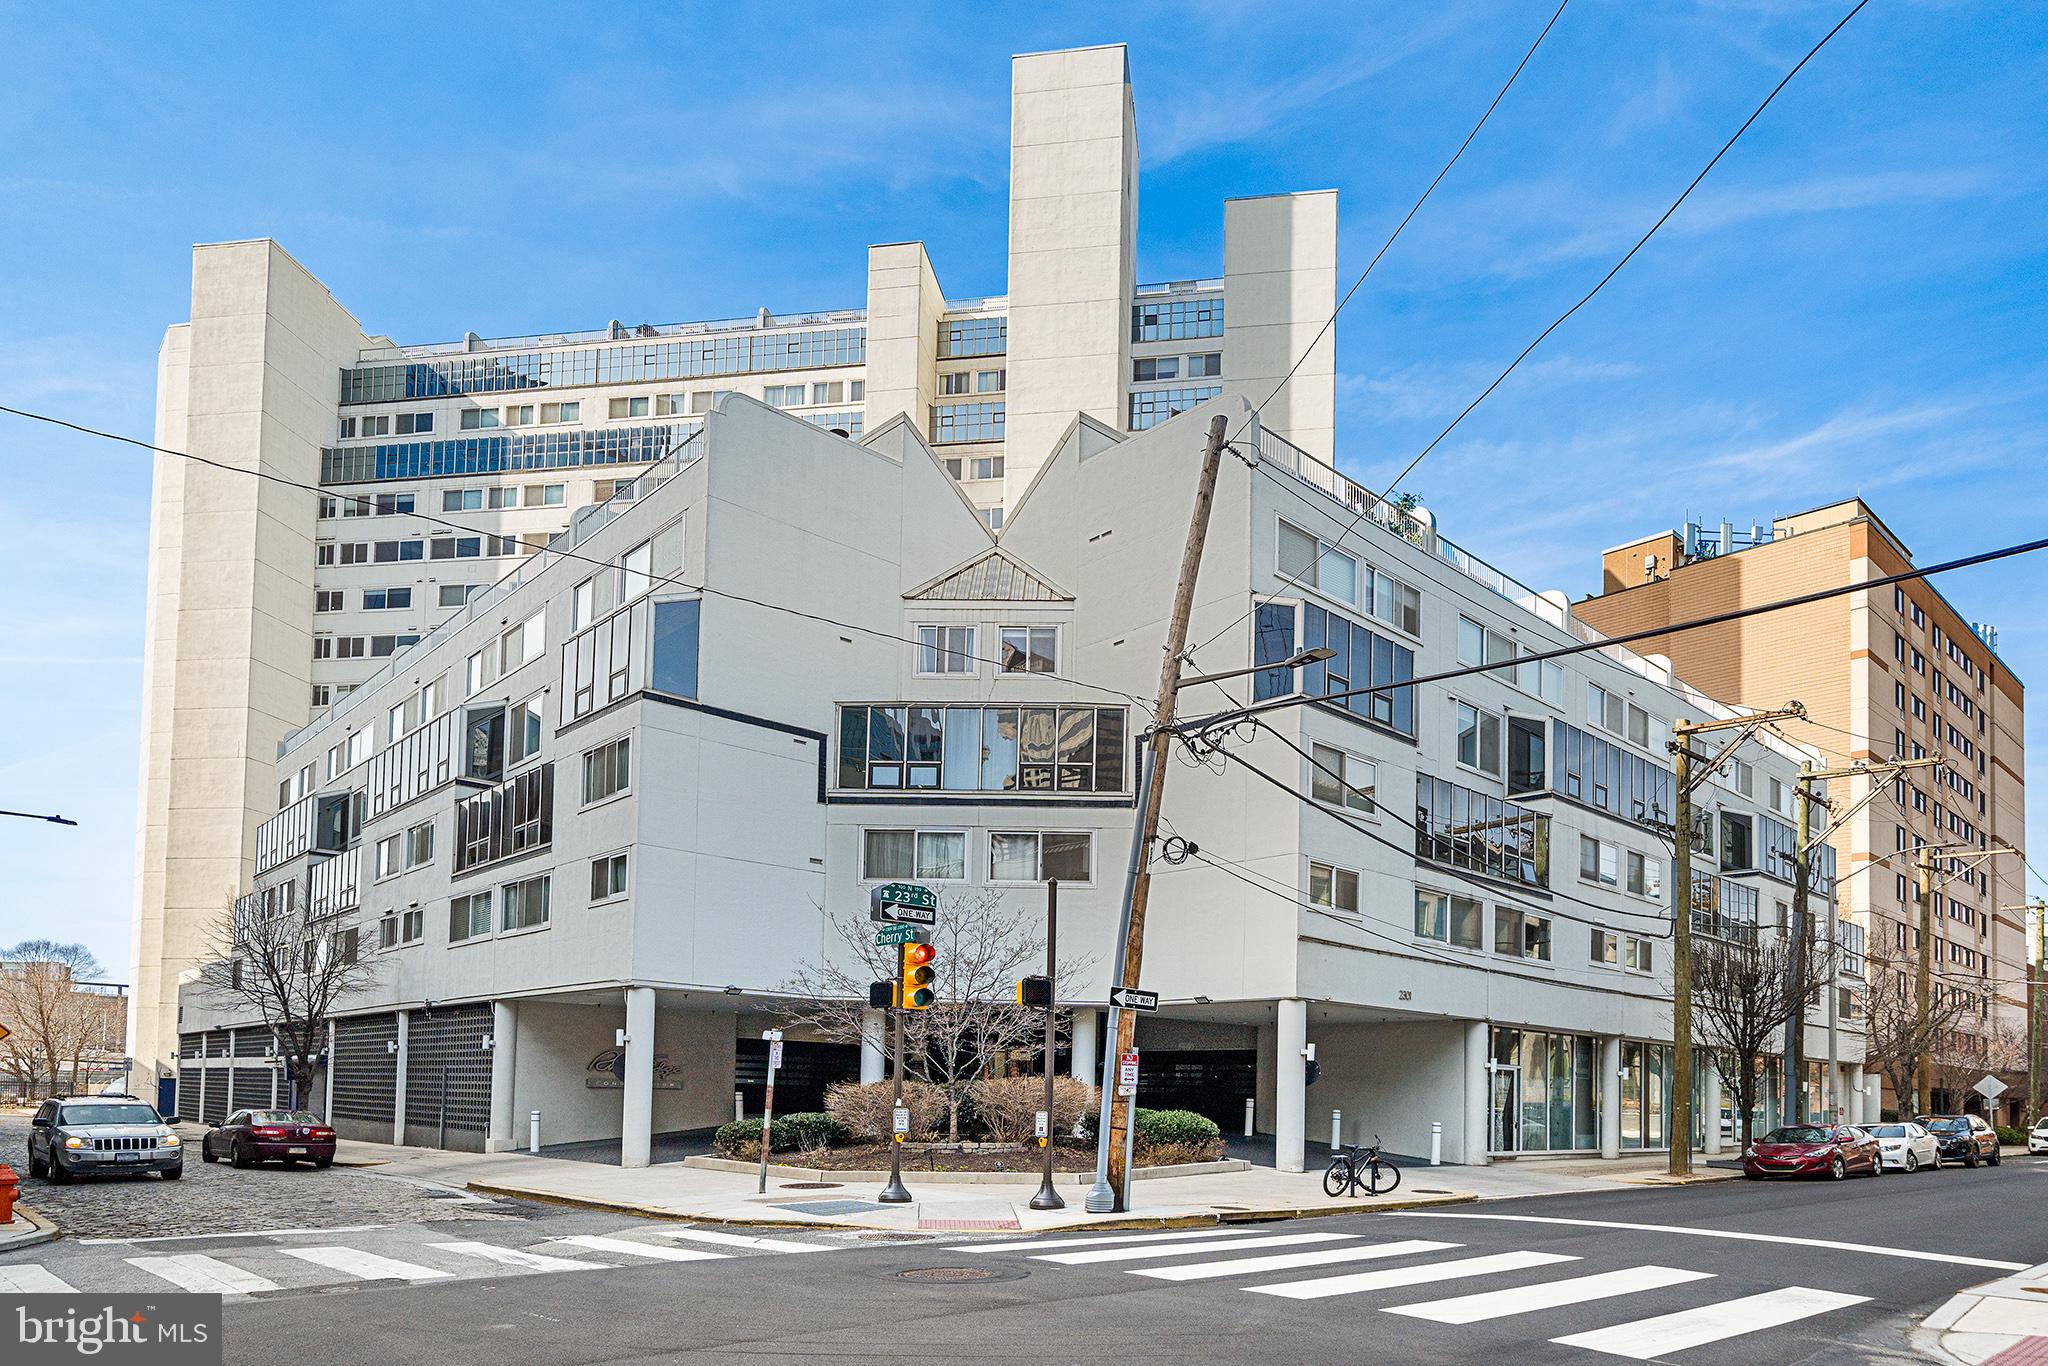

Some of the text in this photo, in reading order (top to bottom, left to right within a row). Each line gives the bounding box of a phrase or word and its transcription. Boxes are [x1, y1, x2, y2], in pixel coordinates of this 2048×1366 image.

[894, 891, 935, 906] 23rd St
[897, 908, 930, 919] ONE WAY
[876, 932, 902, 944] Cherry
[905, 928, 914, 940] St
[1125, 994, 1153, 1005] ONE WAY
